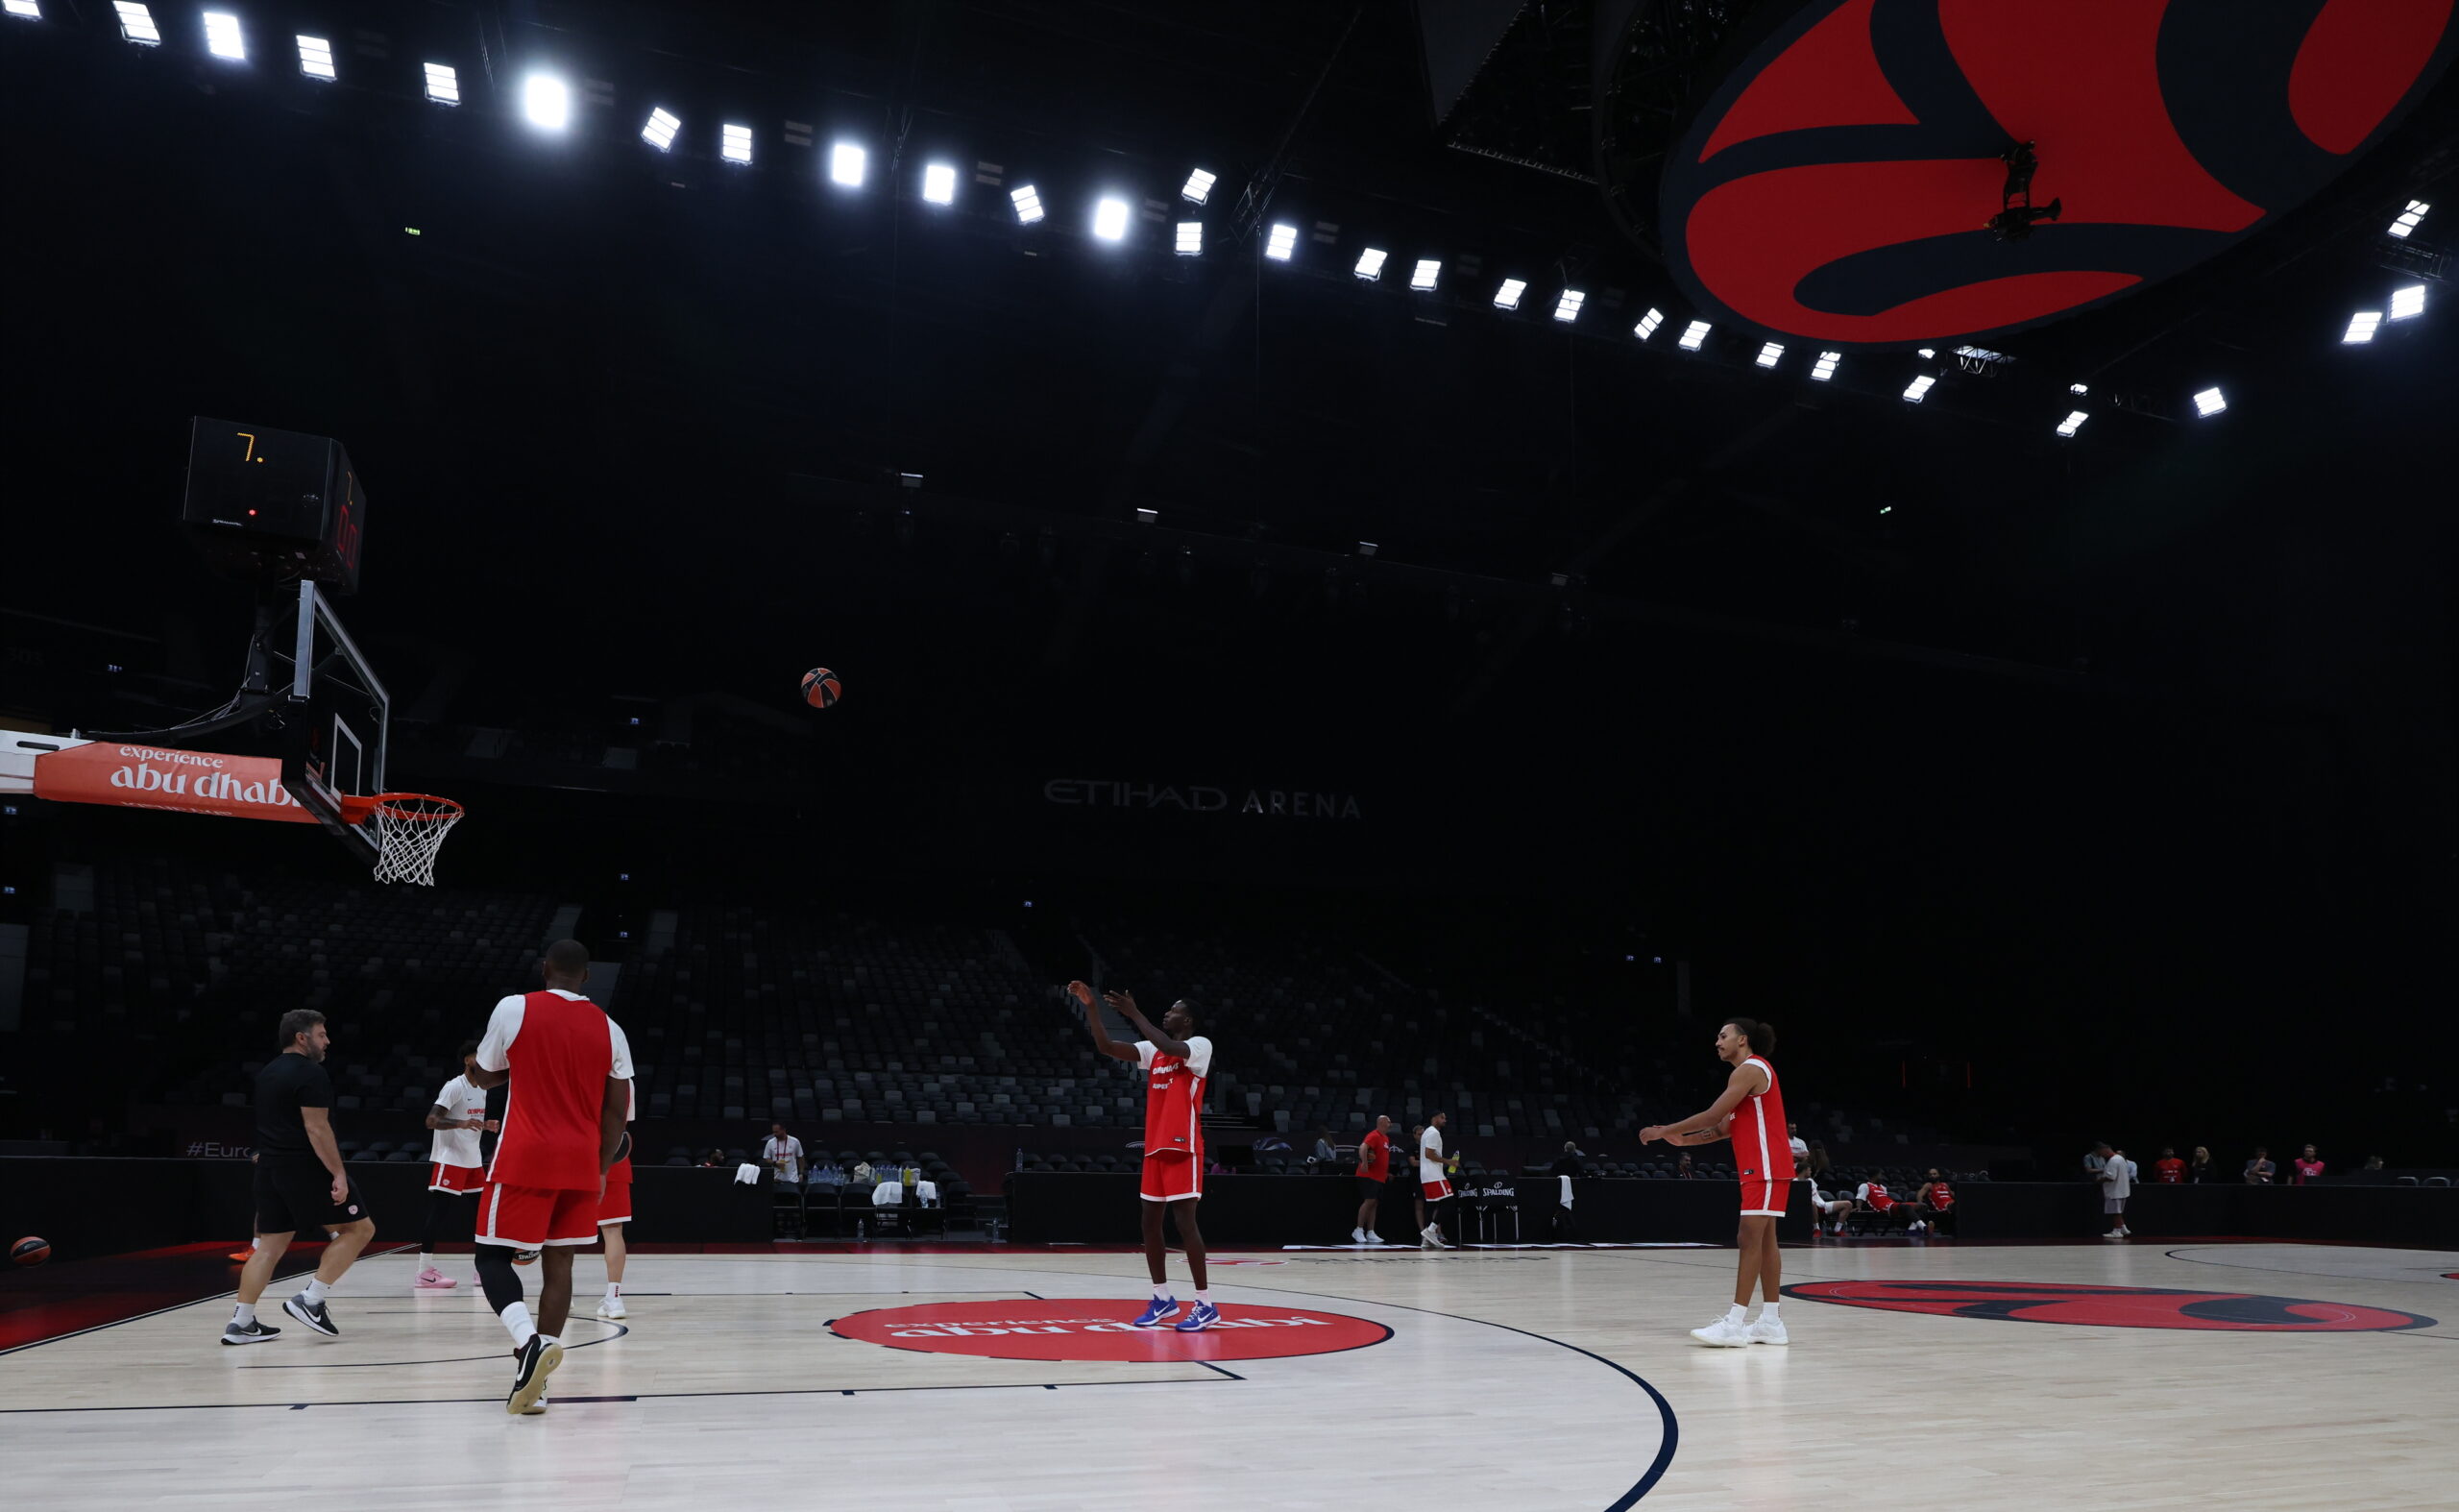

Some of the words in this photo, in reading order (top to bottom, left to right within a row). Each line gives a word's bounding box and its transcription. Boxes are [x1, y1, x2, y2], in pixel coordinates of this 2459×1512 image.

[119, 744, 224, 768] experience
[110, 763, 186, 794] abu
[1043, 777, 1229, 812] ETIHAD
[1241, 789, 1361, 818] ARENA
[1482, 1187, 1515, 1197] SPALDING
[884, 1317, 1117, 1329] experience
[890, 1326, 1076, 1337] abu
